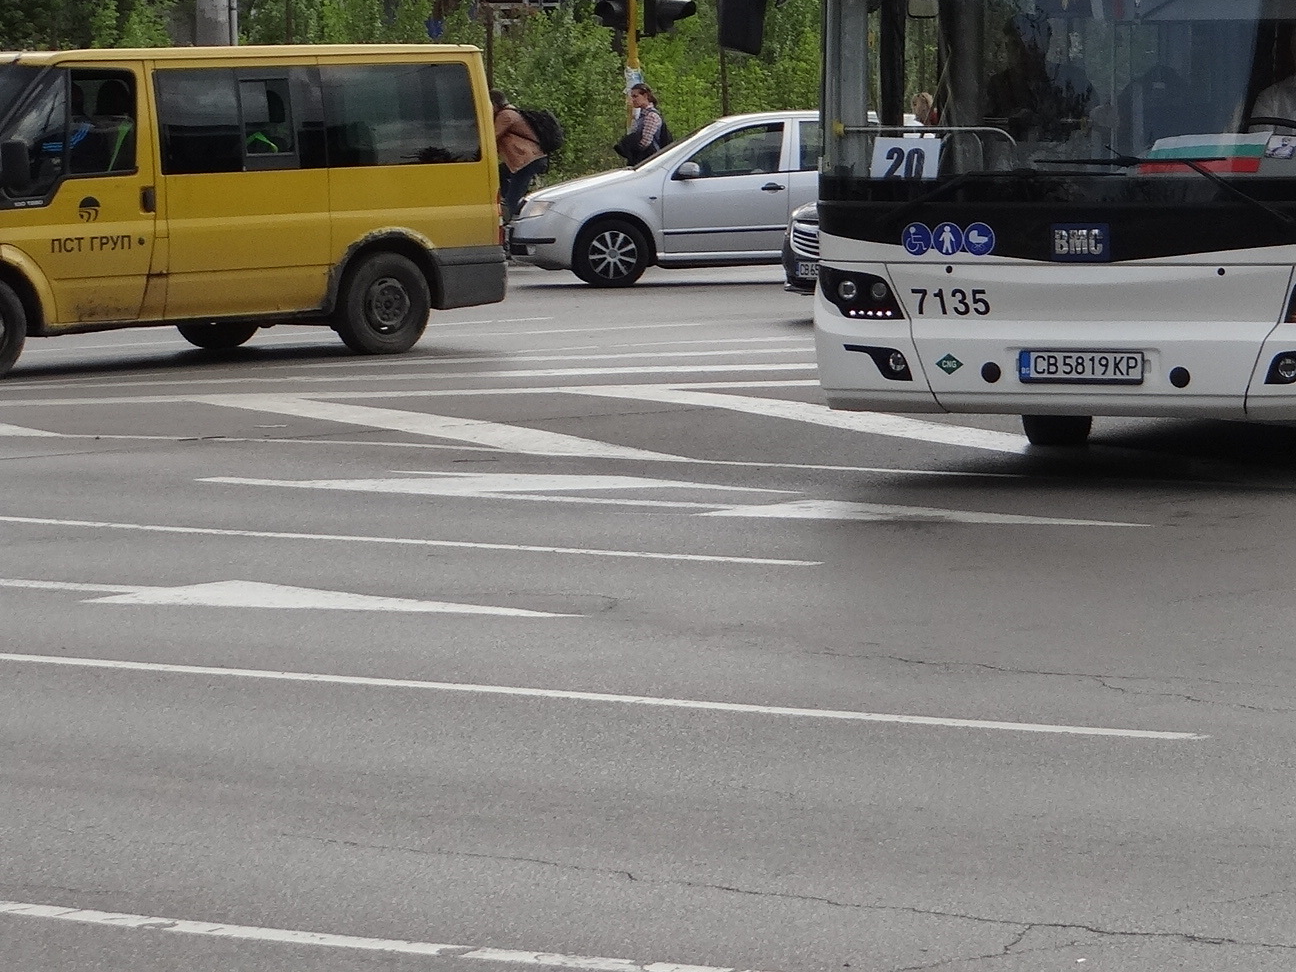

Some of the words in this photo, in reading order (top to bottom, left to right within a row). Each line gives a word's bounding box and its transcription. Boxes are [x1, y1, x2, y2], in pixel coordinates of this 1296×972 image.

[883, 146, 925, 179] 20
[51, 236, 84, 254] ПСТ
[90, 234, 132, 251] ГРУП
[1054, 228, 1103, 255] BMC
[910, 288, 991, 316] 7135
[941, 359, 958, 369] CNG
